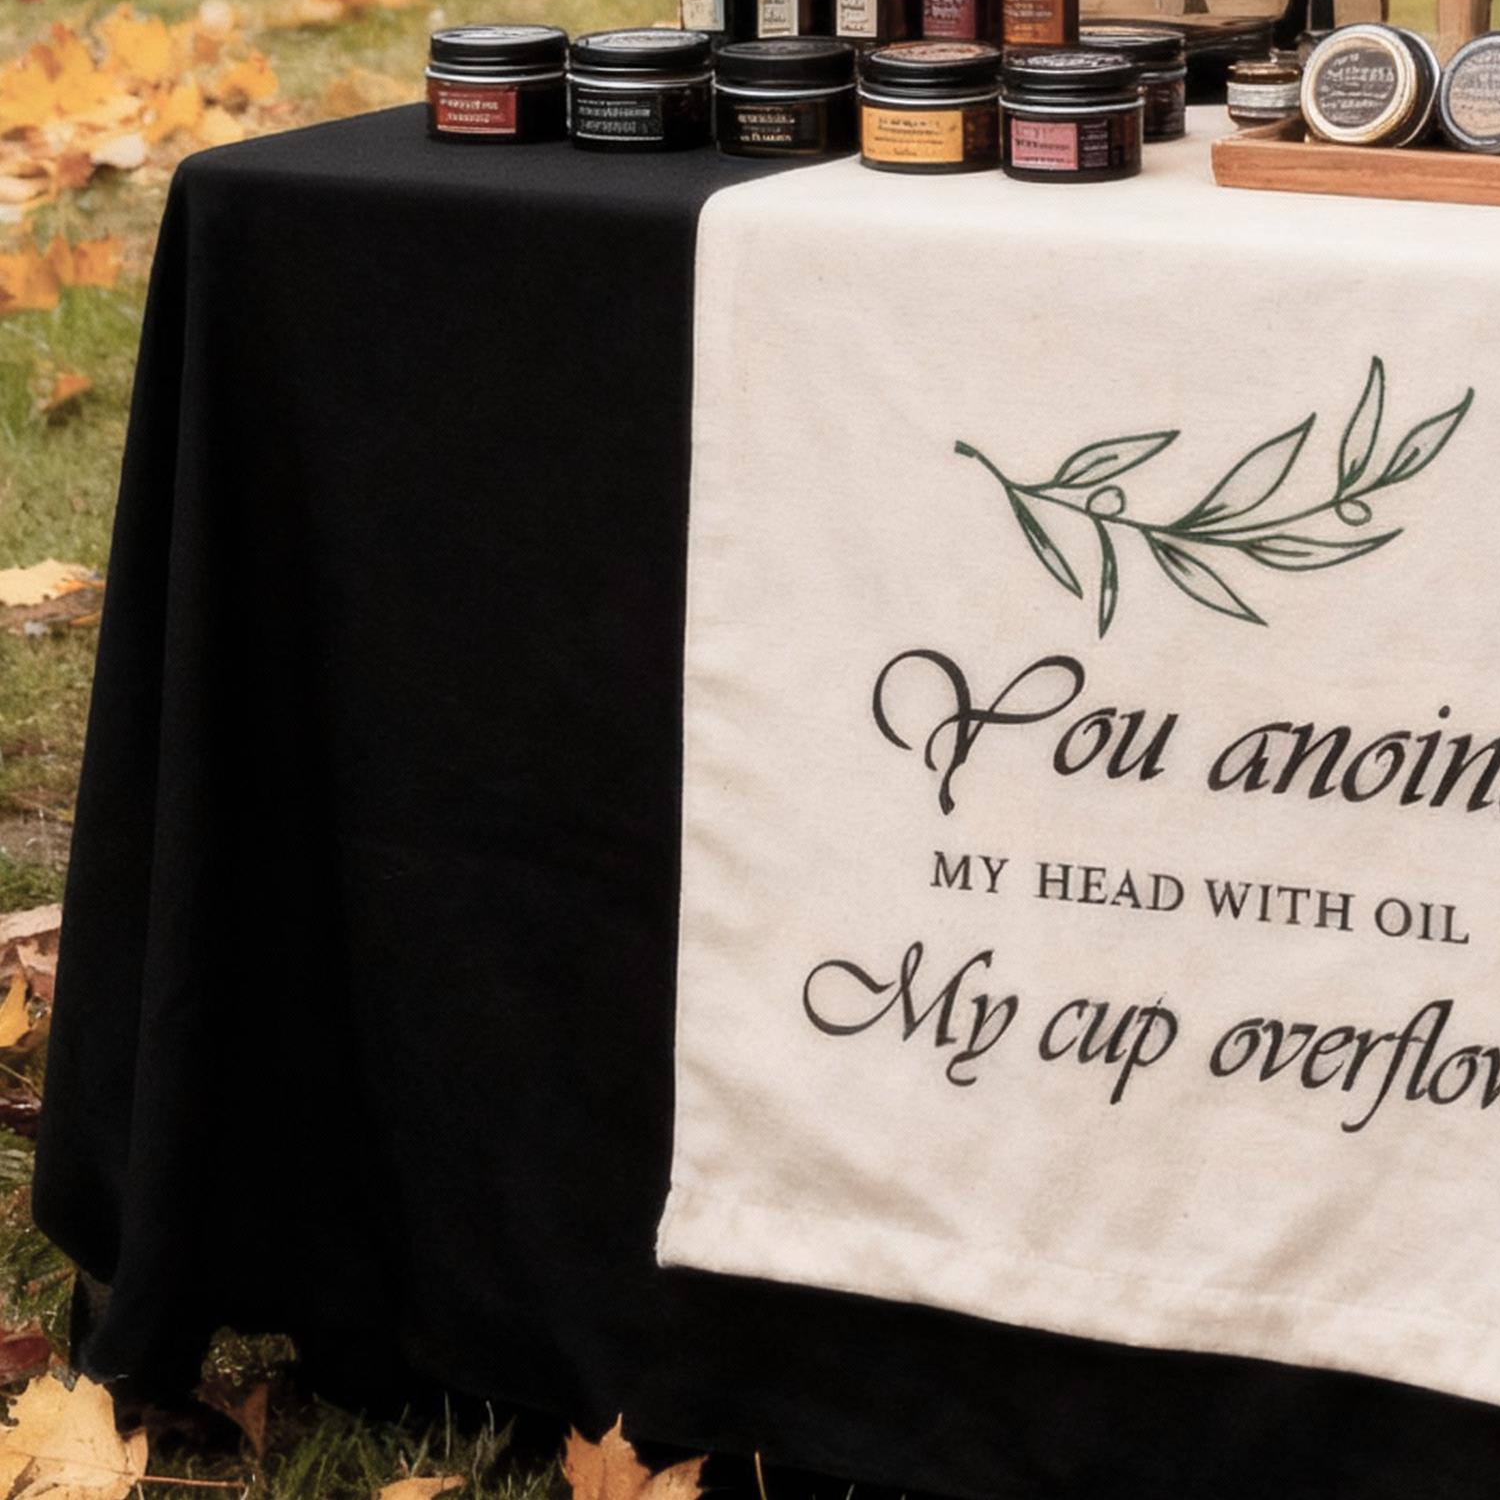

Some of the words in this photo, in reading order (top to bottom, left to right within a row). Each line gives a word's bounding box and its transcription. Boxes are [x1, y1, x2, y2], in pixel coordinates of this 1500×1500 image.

[872, 649, 1179, 816] You
[930, 851, 1009, 893] MY
[1035, 862, 1184, 911] HEAD
[1204, 879, 1355, 932] WITH
[1374, 898, 1469, 944] OIL
[803, 941, 1019, 1087] My
[1038, 995, 1178, 1105] cup
